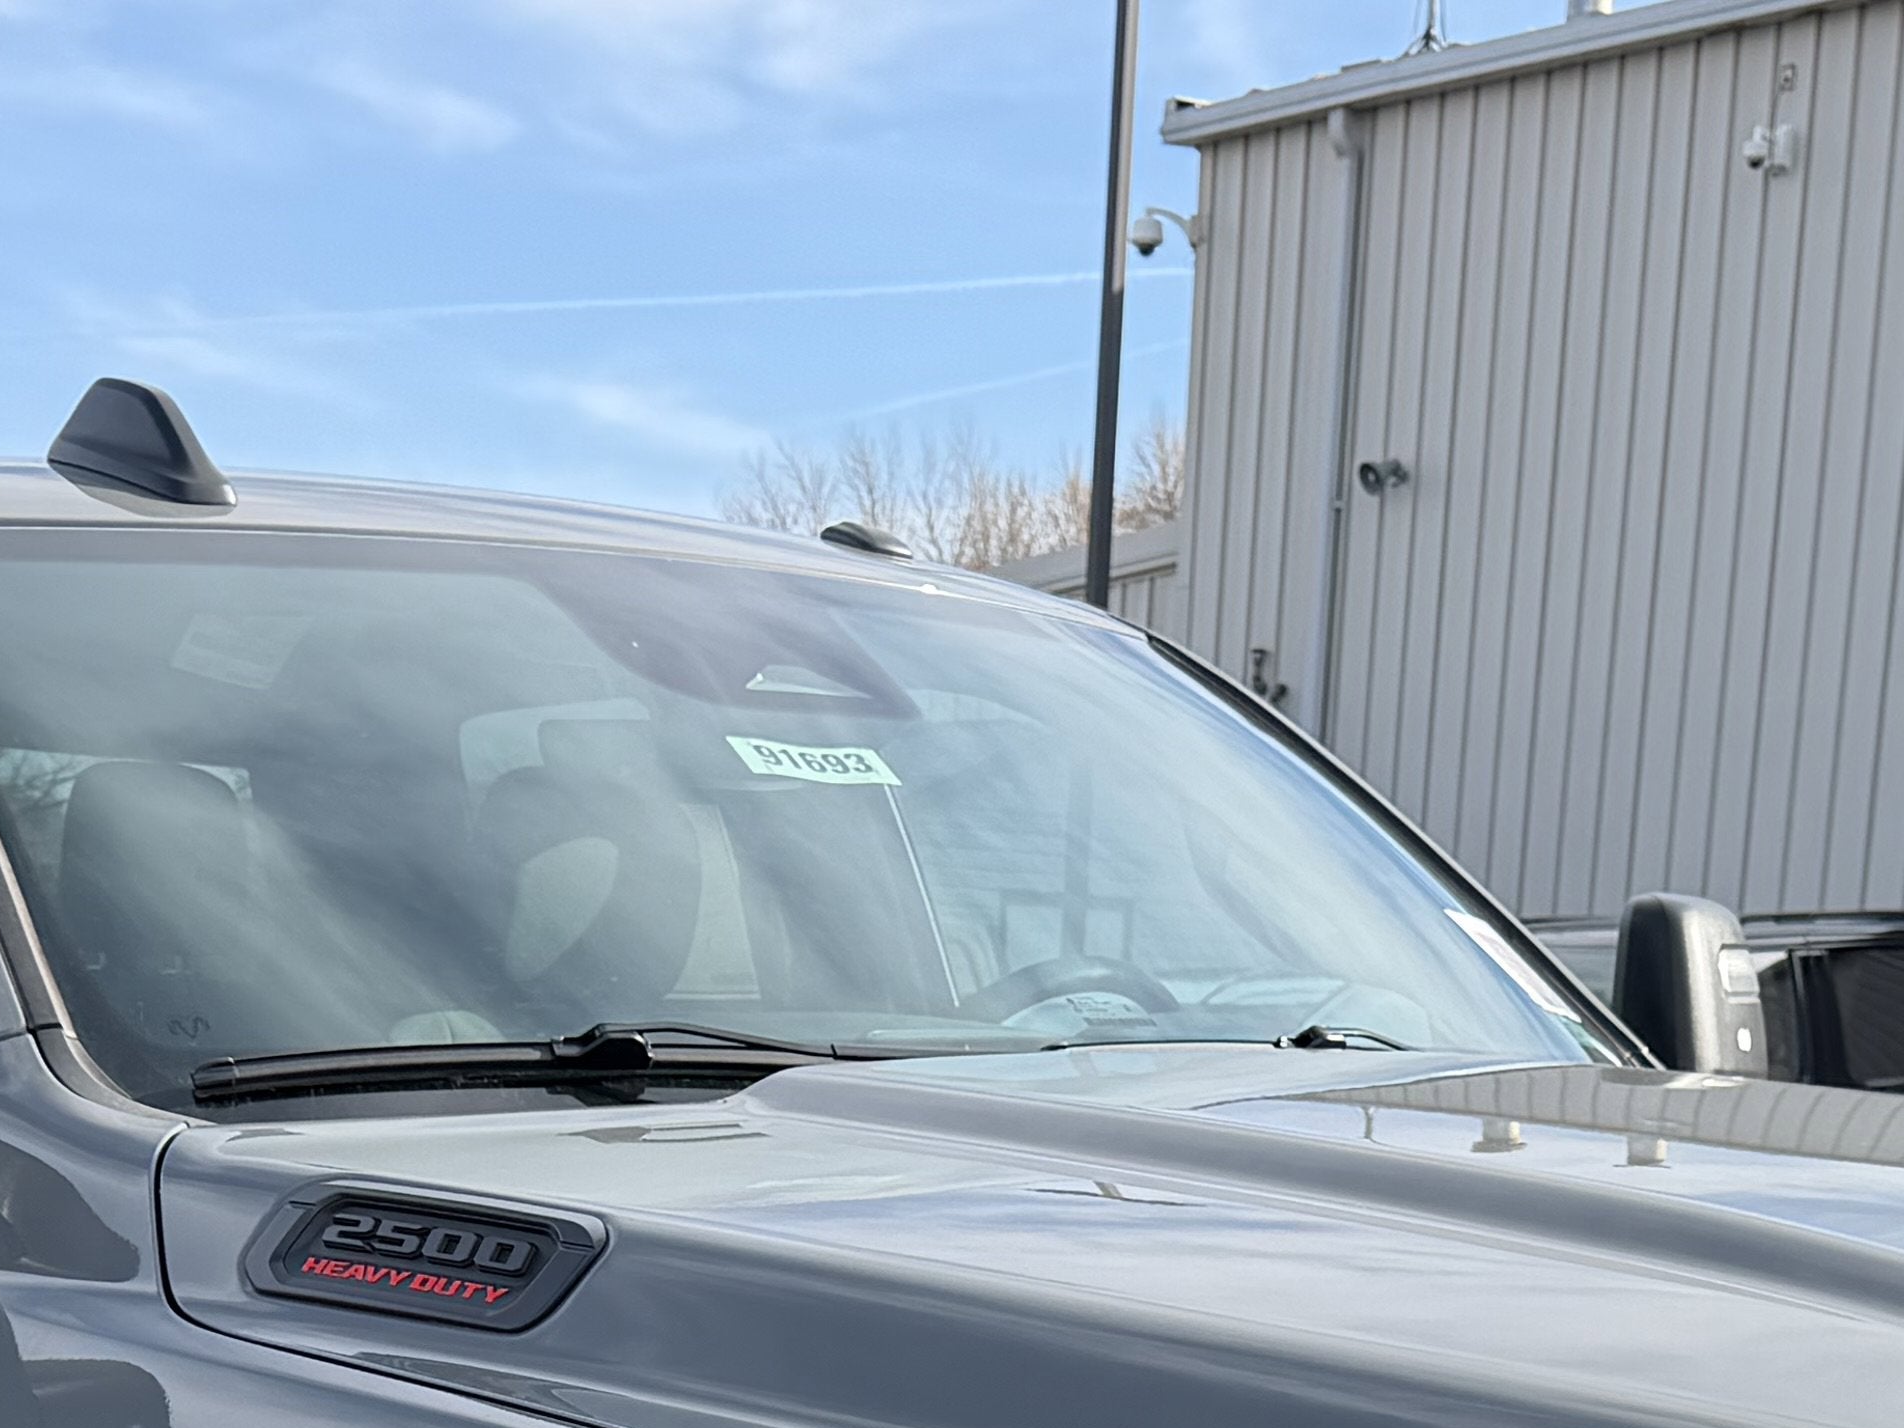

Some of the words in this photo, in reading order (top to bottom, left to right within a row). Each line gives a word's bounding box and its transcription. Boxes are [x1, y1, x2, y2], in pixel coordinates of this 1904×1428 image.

[752, 744, 875, 775] 91693
[321, 1212, 538, 1276] 2500
[301, 1257, 412, 1287] HEAVY
[408, 1275, 510, 1304] DUTY
